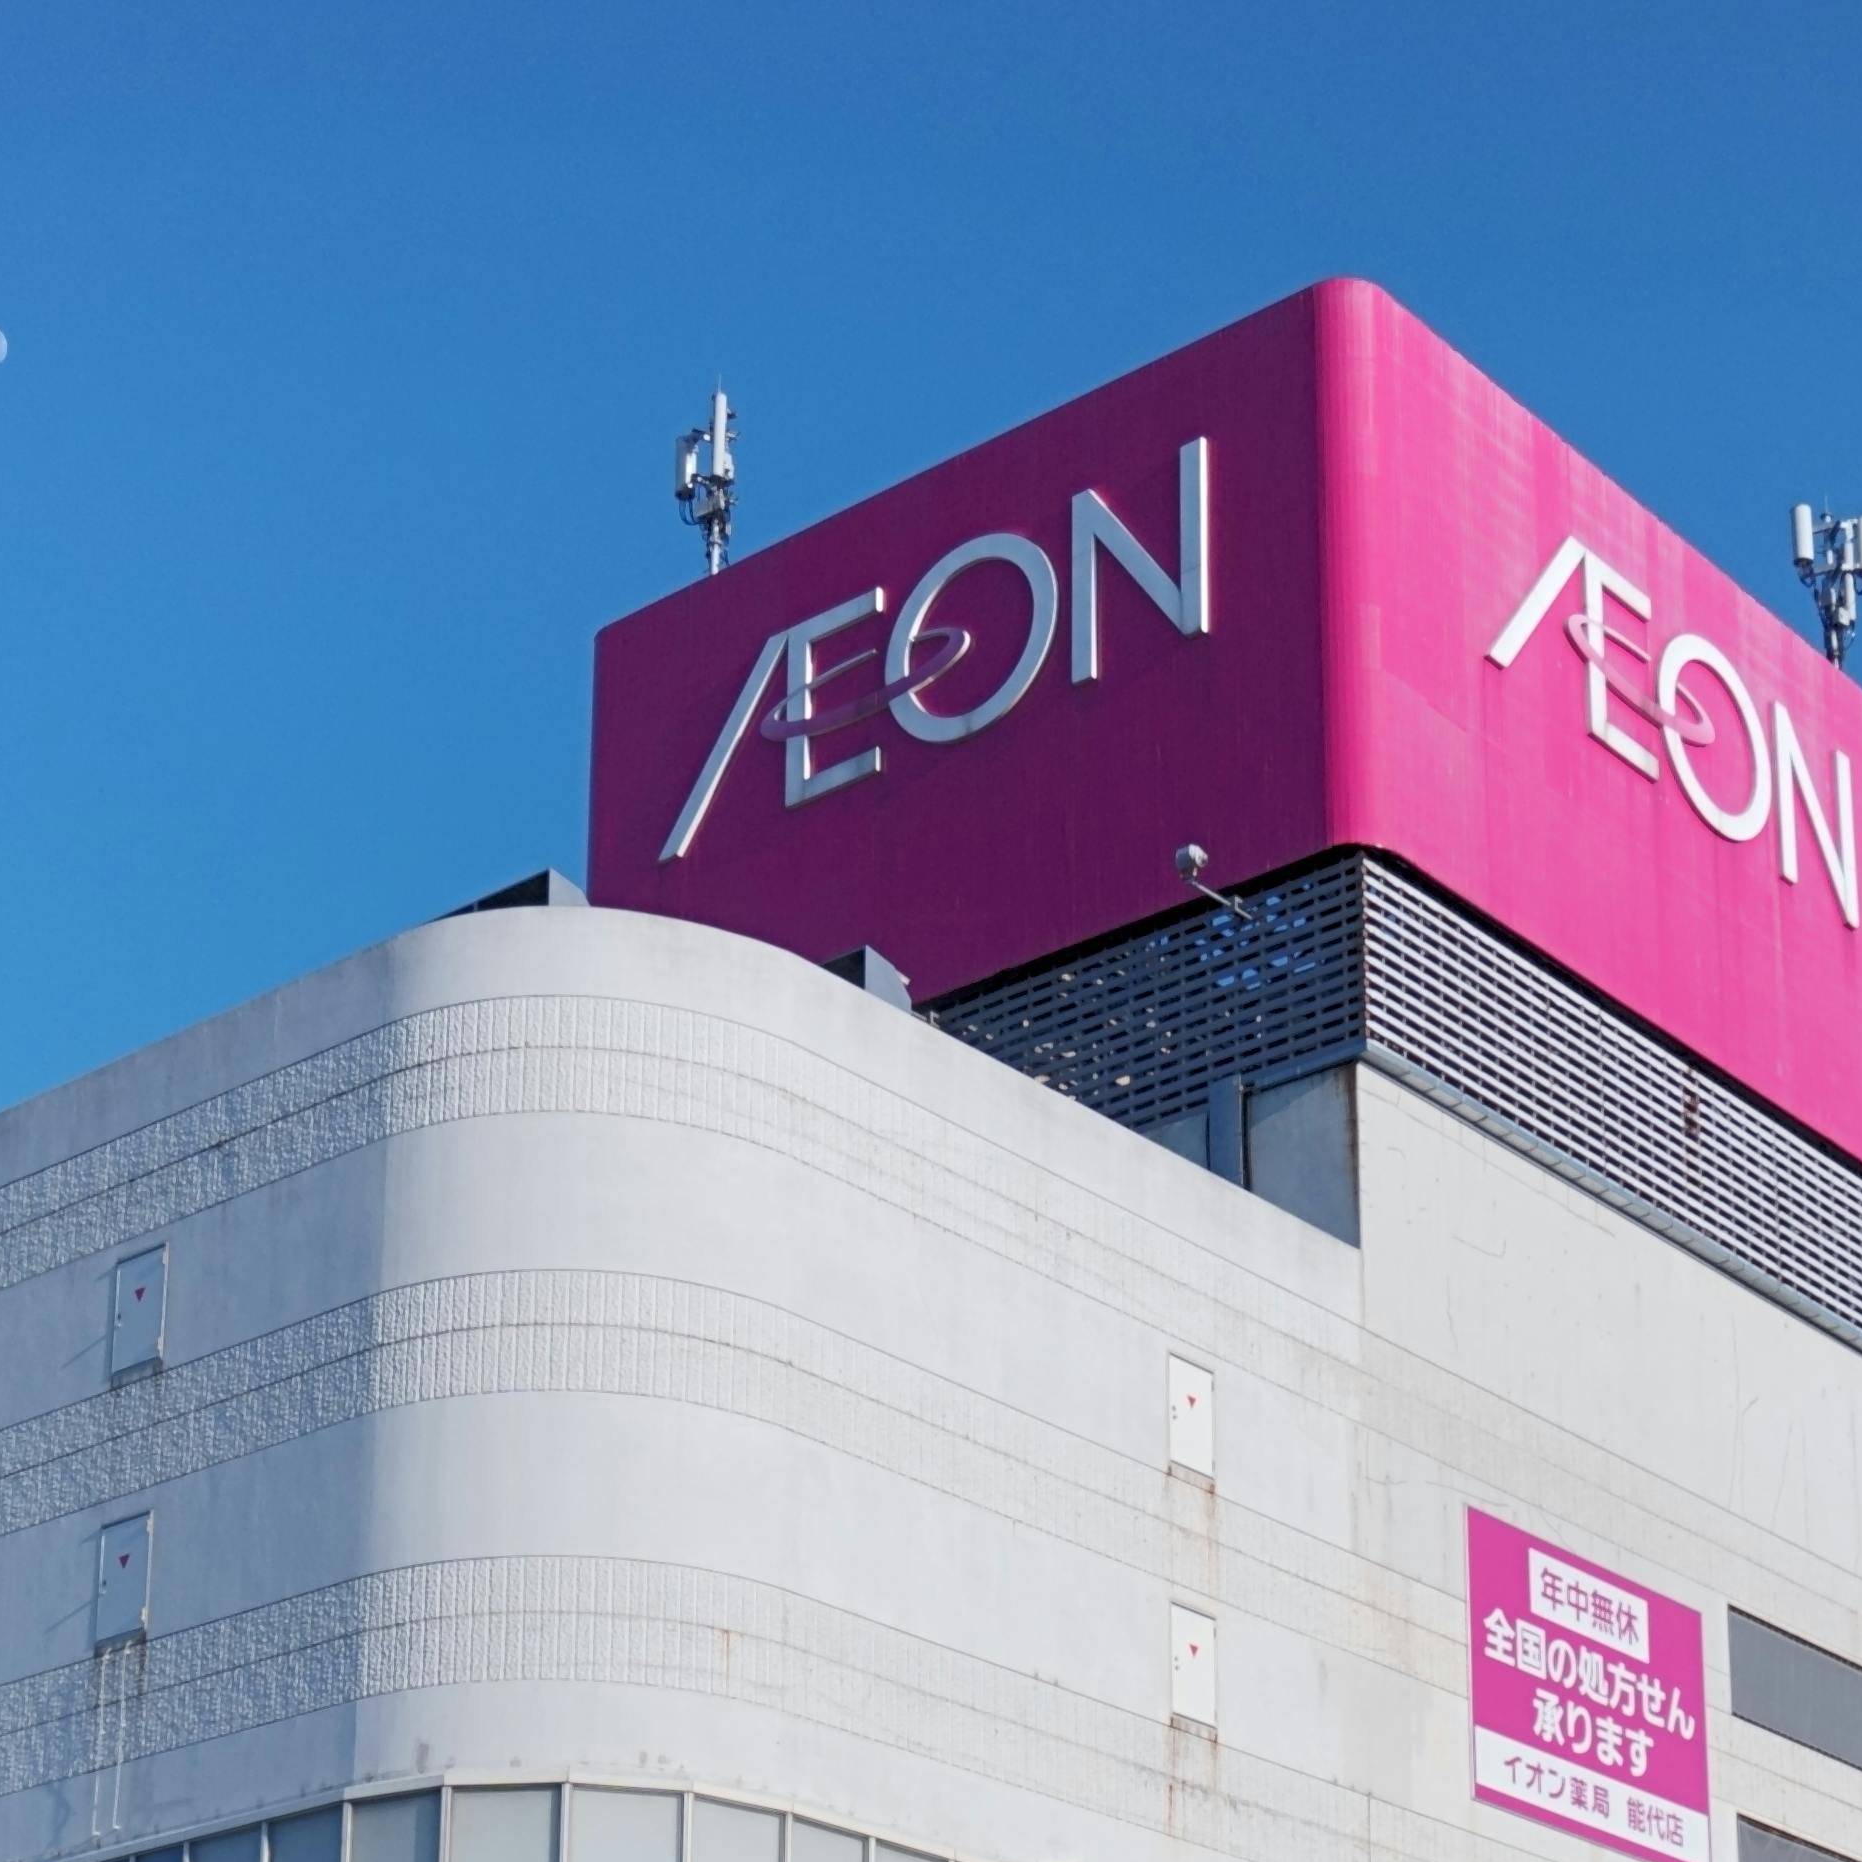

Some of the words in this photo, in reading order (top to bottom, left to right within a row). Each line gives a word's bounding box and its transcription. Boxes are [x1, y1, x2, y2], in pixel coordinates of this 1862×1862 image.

[1540, 1566, 1640, 1646] 年中無休
[1482, 1607, 1695, 1741] 全国の処方せん
[1532, 1687, 1654, 1778] 承ります
[1503, 1755, 1610, 1819] イオン薬局
[1626, 1796, 1684, 1848] 能代店
